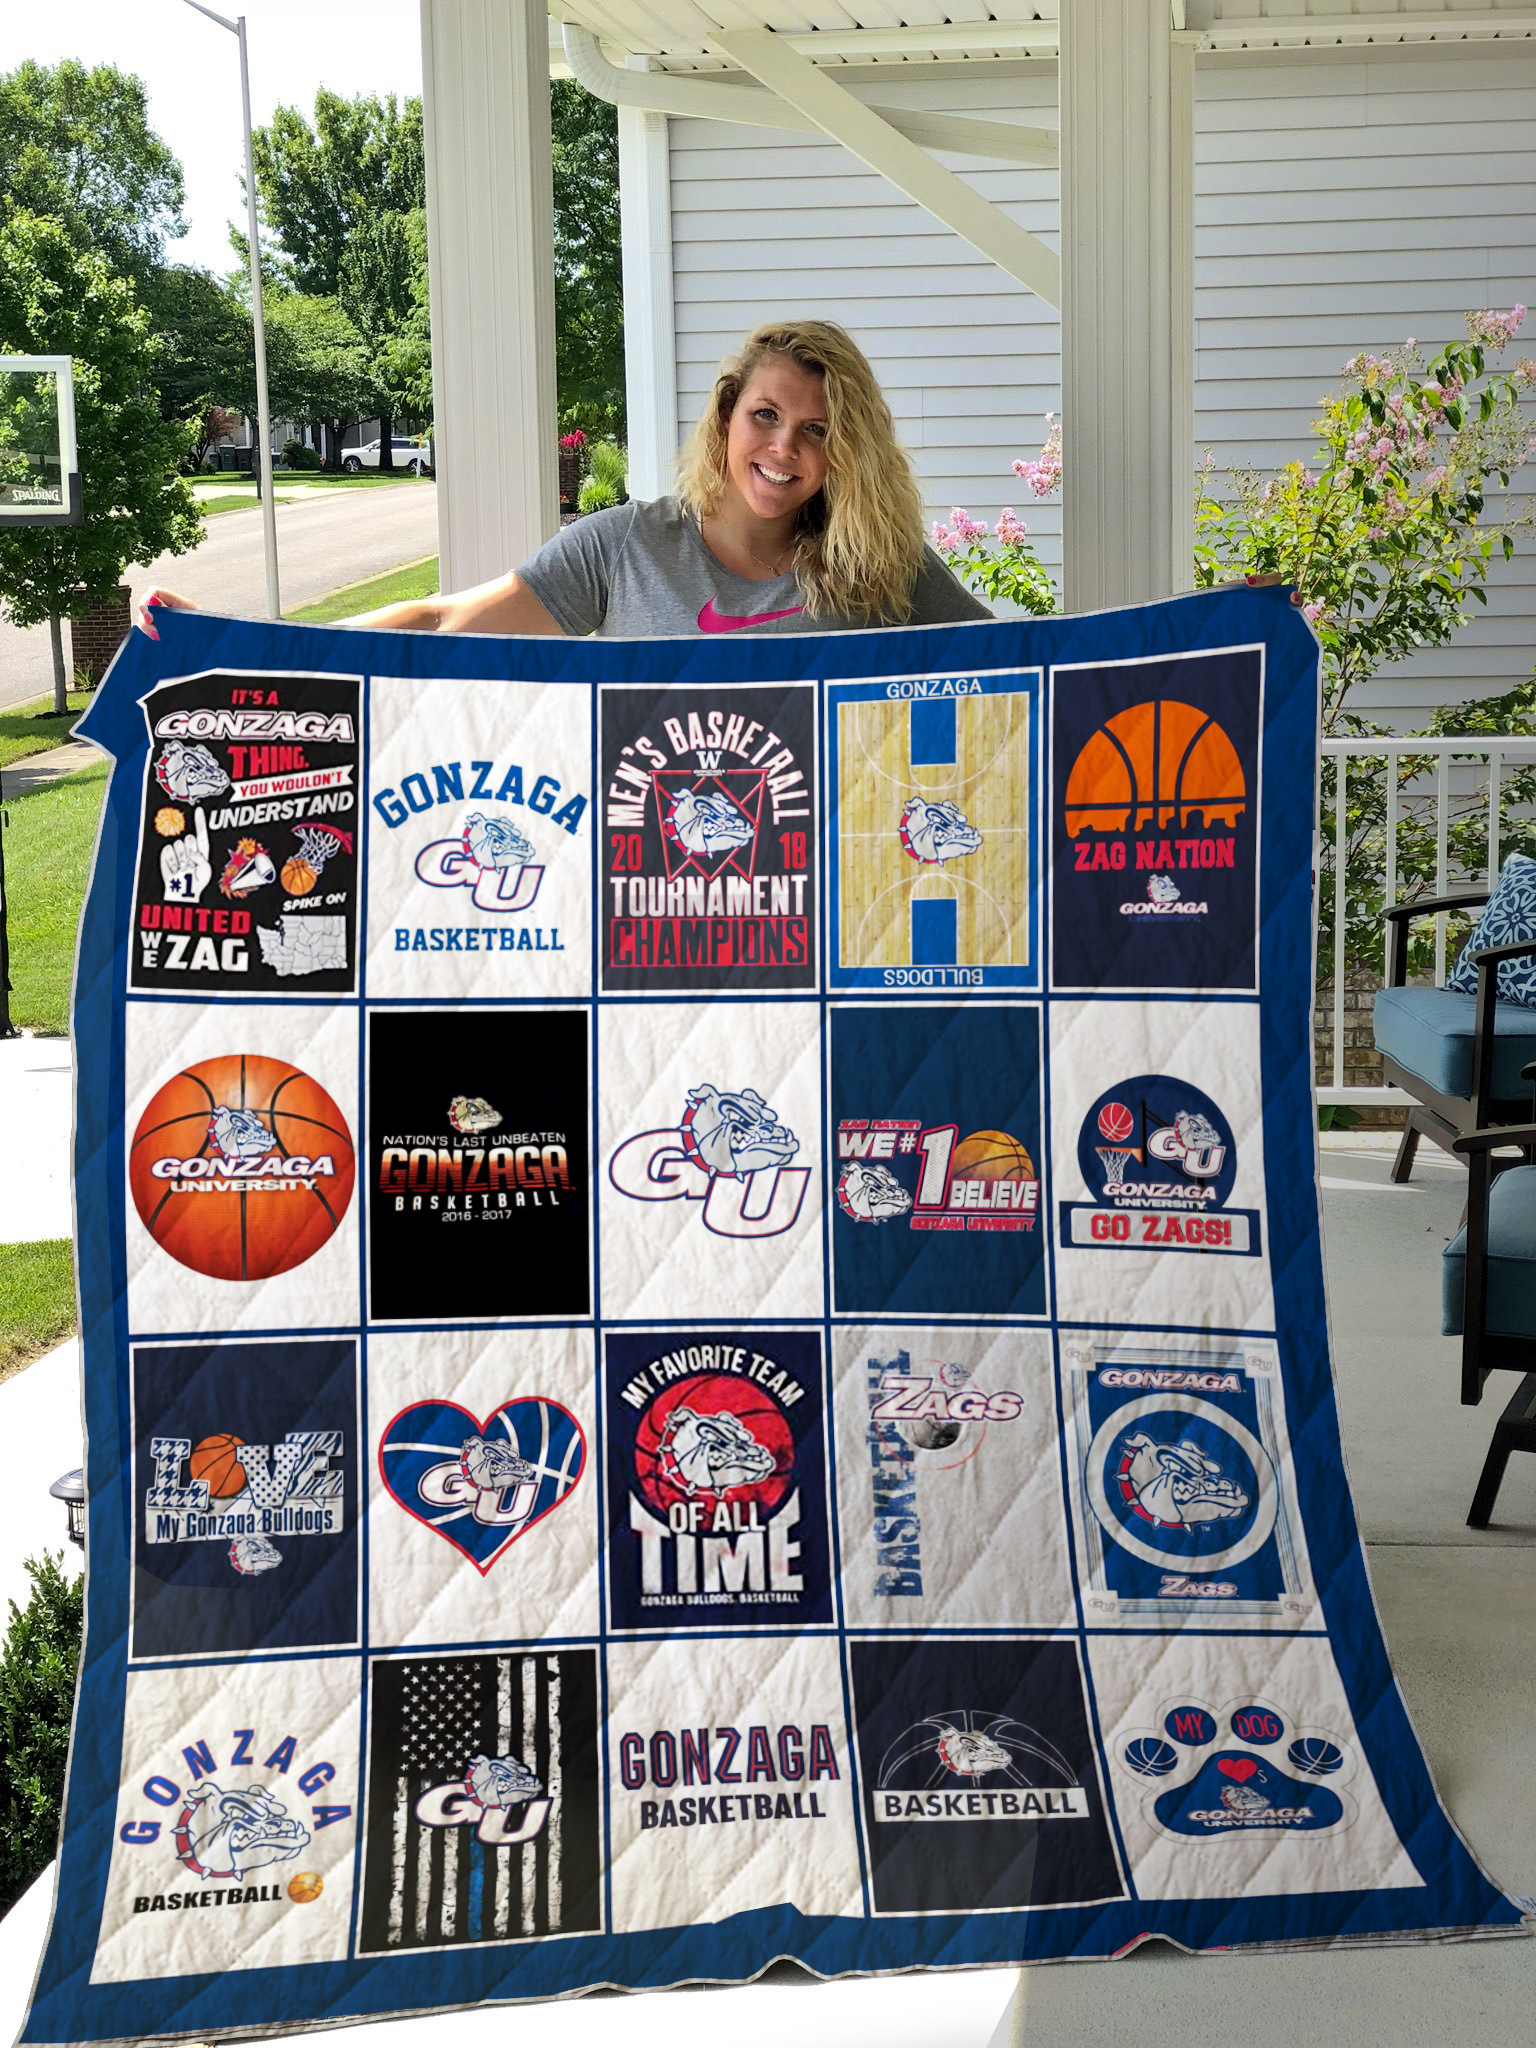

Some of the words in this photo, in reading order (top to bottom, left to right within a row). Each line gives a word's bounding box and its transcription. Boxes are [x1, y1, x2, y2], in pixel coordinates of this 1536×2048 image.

[13, 490, 60, 502] SPALDING
[232, 690, 263, 705] IT'S
[266, 690, 279, 705] A
[886, 678, 983, 698] GONZAGA
[155, 710, 355, 743] GONZAGA
[696, 750, 722, 770] W
[240, 781, 268, 798] YOU
[271, 770, 343, 794] WOULDN'T
[607, 735, 668, 827] MEN'S
[208, 791, 354, 831] UNDERSTAND
[372, 761, 588, 835] GONZAGA
[611, 833, 643, 871] 20
[778, 831, 806, 870] 18
[1074, 840, 1126, 871] ZAG
[1136, 838, 1235, 870] NATION
[170, 872, 196, 898] #1
[610, 874, 808, 917] TOURNAMENT
[282, 896, 322, 912] SPIKE
[326, 892, 346, 905] ON
[1119, 901, 1209, 915] GONZAGA
[140, 904, 250, 934] UNITED
[394, 928, 564, 951] BASKETBALL
[612, 918, 806, 966] CHAMPIONS
[164, 935, 249, 972] ZAG
[884, 968, 984, 986] BULLDOGS
[383, 1136, 448, 1146] NATION'S
[454, 1136, 488, 1147] LAST
[492, 1132, 566, 1146] UNBEATEN
[838, 1130, 899, 1160] WE
[152, 1155, 336, 1178] GONZAGA
[379, 1145, 573, 1193] GONZAGA
[170, 1178, 318, 1193] UNIVERSITY
[948, 1179, 1040, 1210] BELIEVE
[1102, 1182, 1218, 1200] GONZAGA
[396, 1190, 560, 1211] BASKETBALL
[1114, 1198, 1207, 1210] UNIVERSITY
[482, 1210, 512, 1220] 2017
[910, 1217, 964, 1230] GONZAGA
[966, 1217, 1035, 1232] UNIVERSITY
[1091, 1214, 1130, 1241] GO
[1142, 1216, 1232, 1246] ZAGS!
[621, 1372, 655, 1409] MY
[649, 1345, 746, 1386] FAVORITE
[748, 1354, 804, 1407] TEAM
[1099, 1368, 1241, 1393] GONZAGA
[870, 1376, 1024, 1422] ZAGS
[156, 1512, 180, 1542] My
[186, 1511, 256, 1538] Gonzaga
[262, 1506, 334, 1536] Bulldogs
[669, 1502, 706, 1532] OF
[712, 1501, 766, 1532] ALL
[629, 1486, 804, 1594] TIME
[687, 1594, 734, 1605] BULLDOGS
[739, 1592, 800, 1603] BASKETBALL
[1158, 1575, 1237, 1598] ZAGS
[1174, 1713, 1204, 1740] MY
[1235, 1714, 1279, 1738] DOG
[620, 1725, 840, 1790] GONZAGA
[120, 1729, 352, 1845] GONZAGA
[641, 1792, 826, 1830] BASKETBALL
[884, 1792, 1078, 1817] BASKETBALL
[1188, 1806, 1314, 1820] GONZAGA
[1203, 1818, 1304, 1828] UNIVERSITY
[133, 1884, 282, 1914] BASKETBALL
